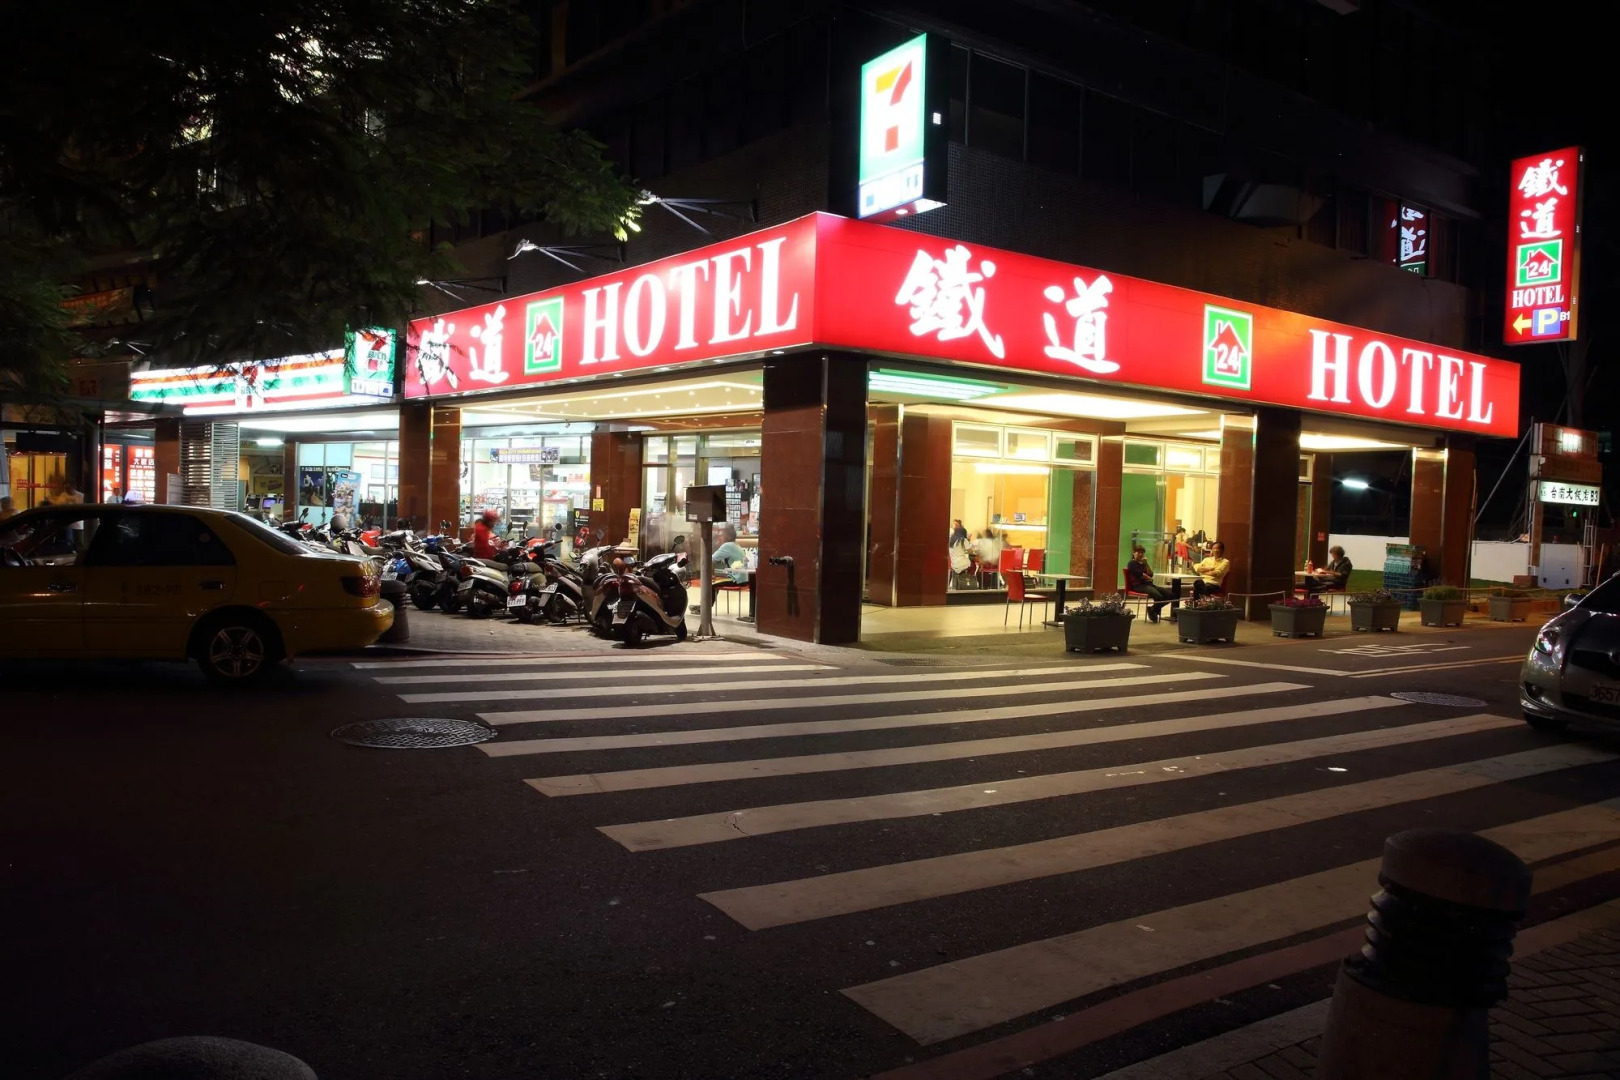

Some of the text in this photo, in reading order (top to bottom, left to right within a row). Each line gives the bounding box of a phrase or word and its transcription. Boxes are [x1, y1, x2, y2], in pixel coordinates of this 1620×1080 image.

[1517, 158, 1568, 239] 鐵道
[1528, 261, 1550, 277] 24
[579, 237, 798, 365] HOTEL
[895, 245, 1121, 374] 鐵道
[1511, 284, 1565, 309] HOTEL
[1538, 308, 1571, 334] P B1
[534, 333, 553, 359] 24
[1217, 346, 1240, 372] 24
[1307, 328, 1494, 425] HOTEL
